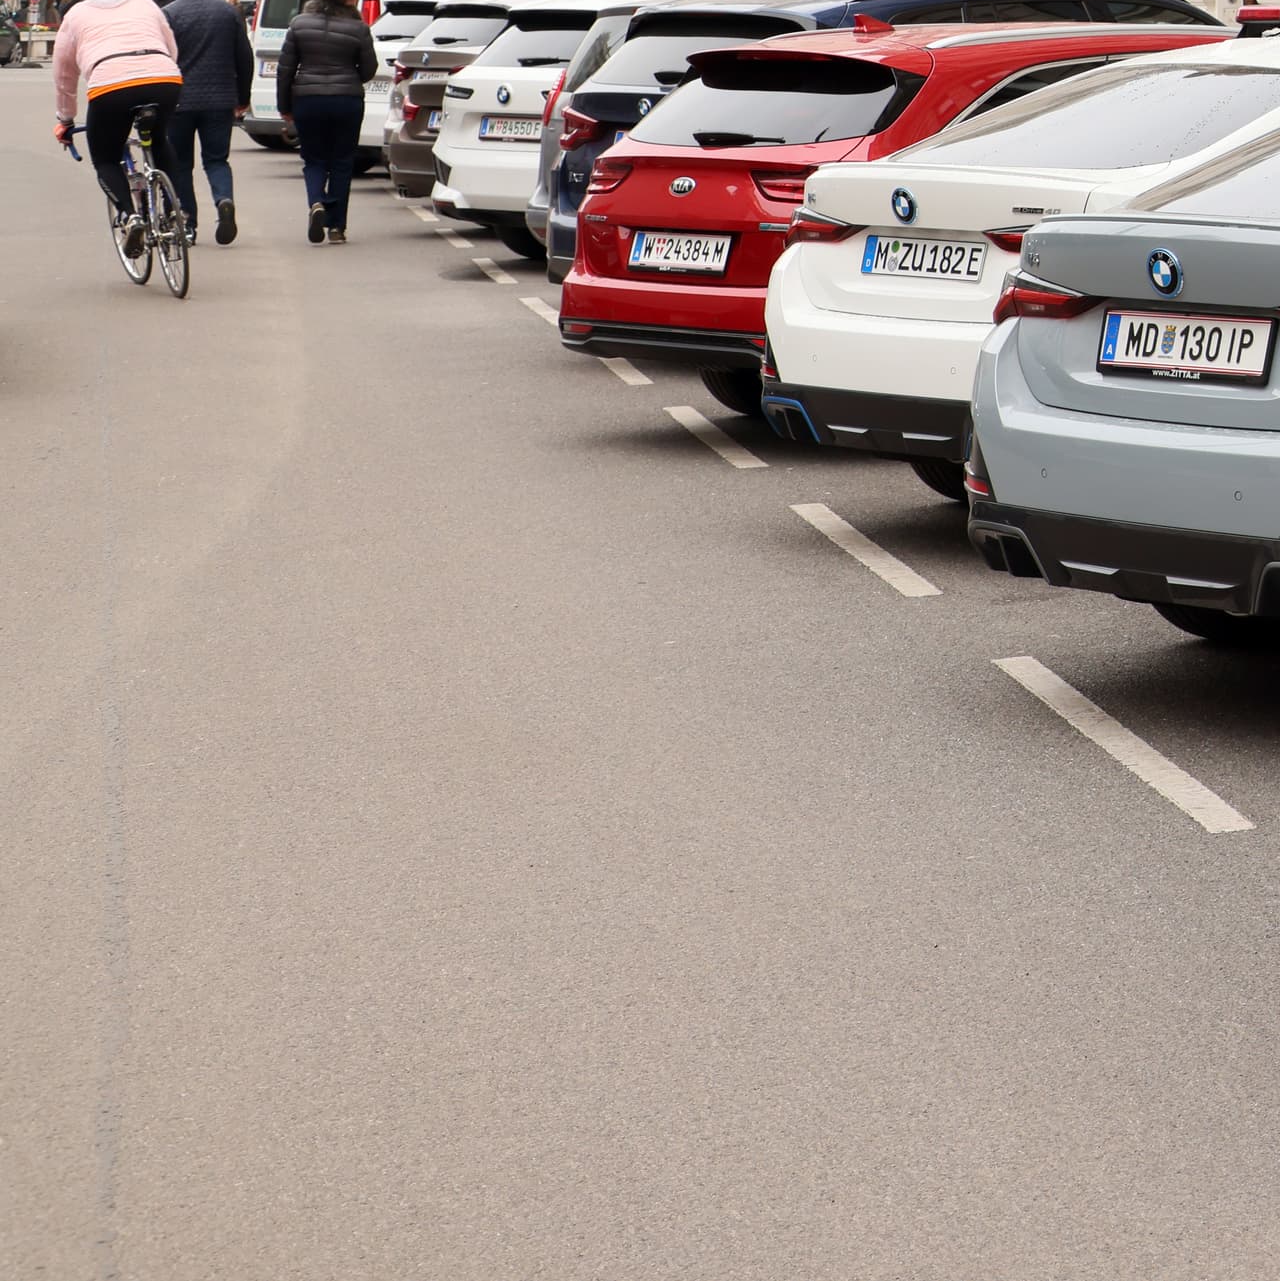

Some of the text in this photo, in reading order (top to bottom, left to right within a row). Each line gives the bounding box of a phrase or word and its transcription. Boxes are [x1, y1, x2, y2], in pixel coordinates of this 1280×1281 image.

[671, 181, 692, 193] KIA
[643, 236, 726, 264] W 24384 M
[874, 240, 889, 270] M
[1105, 343, 1114, 355] A
[1124, 321, 1255, 365] MD 130 IP
[1151, 368, 1201, 381] www.ZITTA.at
